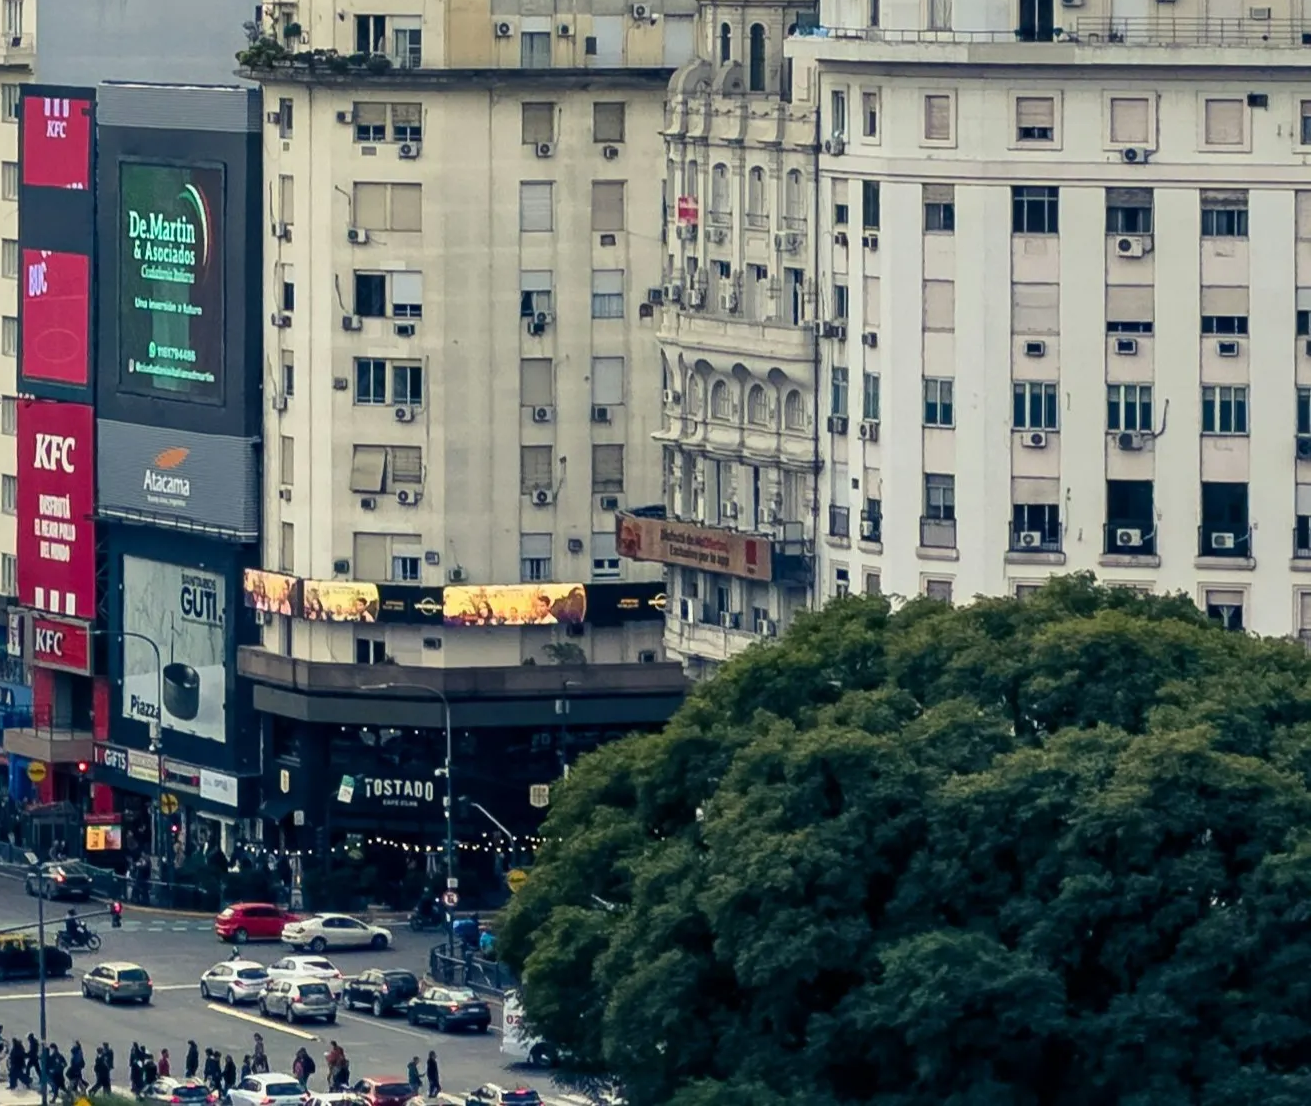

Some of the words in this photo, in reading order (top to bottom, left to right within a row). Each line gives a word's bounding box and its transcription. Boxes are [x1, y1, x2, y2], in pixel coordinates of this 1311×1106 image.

[46, 120, 67, 139] KFC
[134, 239, 142, 260] &
[144, 241, 196, 266] Asociados
[33, 433, 76, 473] KFC
[143, 469, 190, 496] Atacama
[35, 627, 63, 656] KFC
[364, 778, 434, 802] TOSTADO
